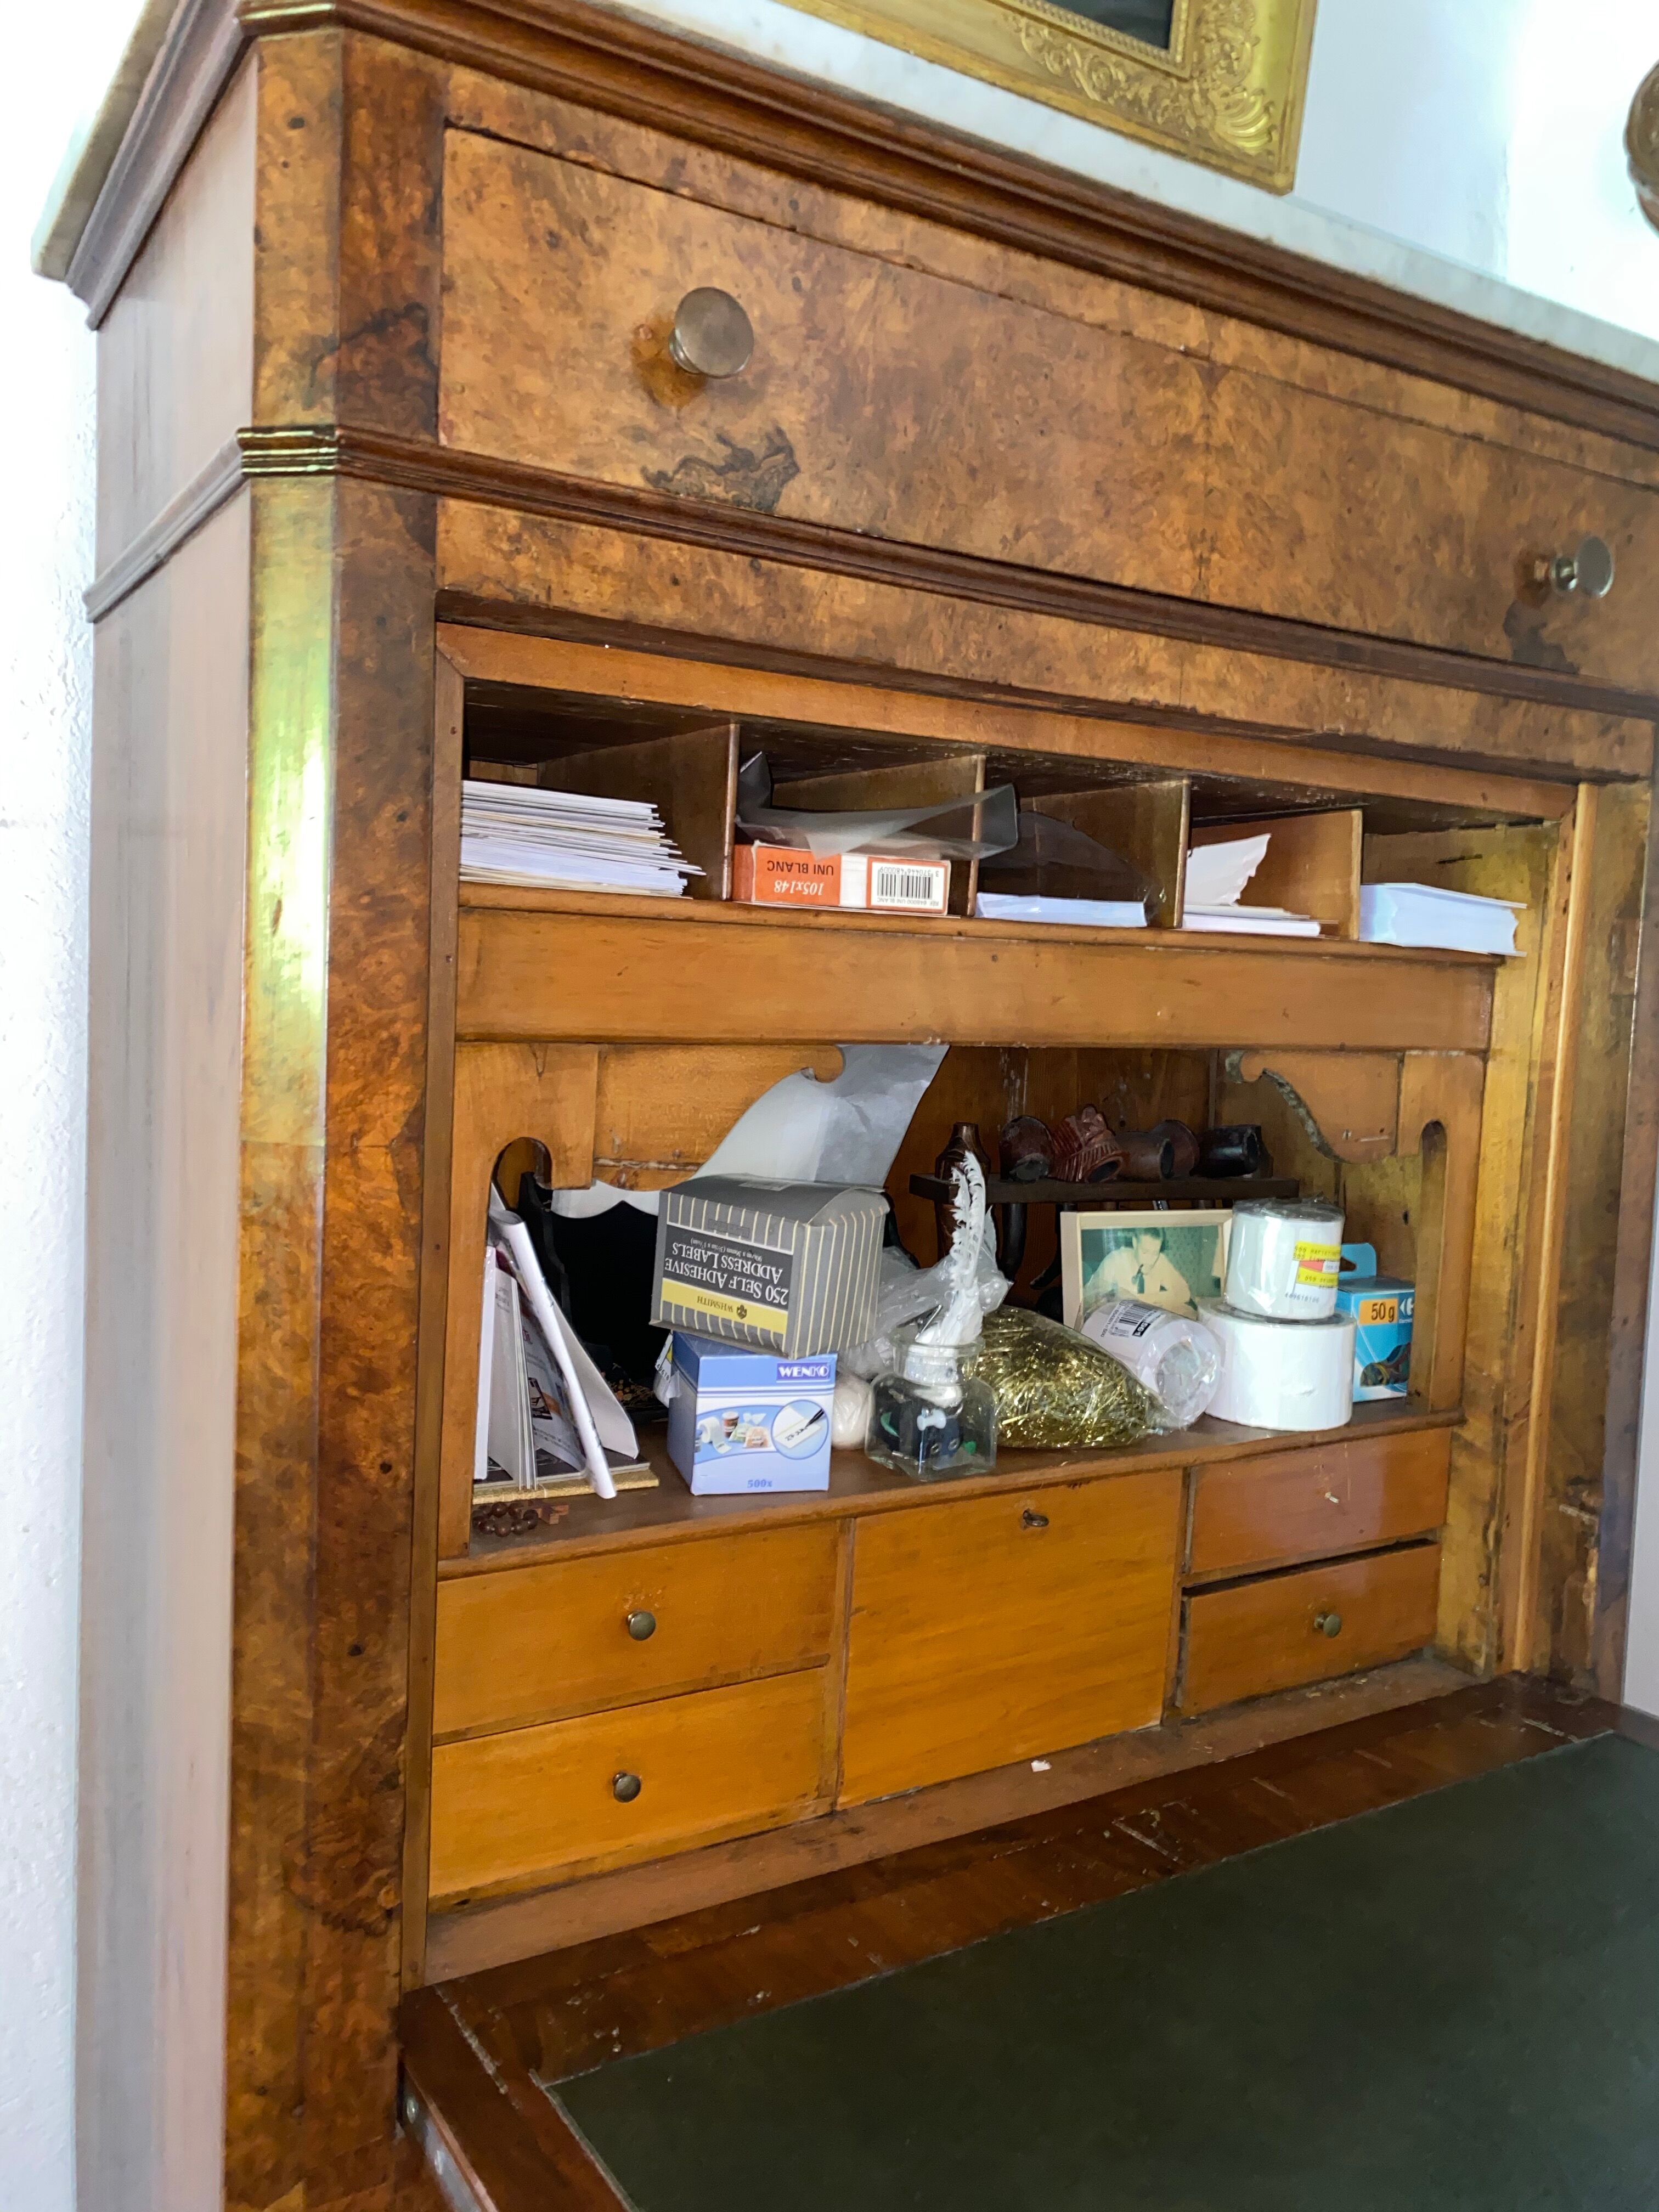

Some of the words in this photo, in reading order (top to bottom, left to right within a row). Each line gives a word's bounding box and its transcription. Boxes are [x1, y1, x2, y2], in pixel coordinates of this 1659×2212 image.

[767, 860, 809, 874] BLANC
[814, 865, 834, 875] UNI
[774, 879, 824, 895] 105x148
[672, 1243, 719, 1269] LABELS
[665, 1258, 727, 1289] ADHESIVE
[721, 1255, 783, 1284] ADDRESS
[729, 1276, 762, 1299] SELF
[765, 1285, 789, 1305] 250
[697, 1295, 733, 1313] WHSMITH
[1372, 1302, 1386, 1321] 50
[1389, 1306, 1395, 1323] g
[778, 1365, 830, 1378] WENKO
[747, 1479, 772, 1488] 500x
